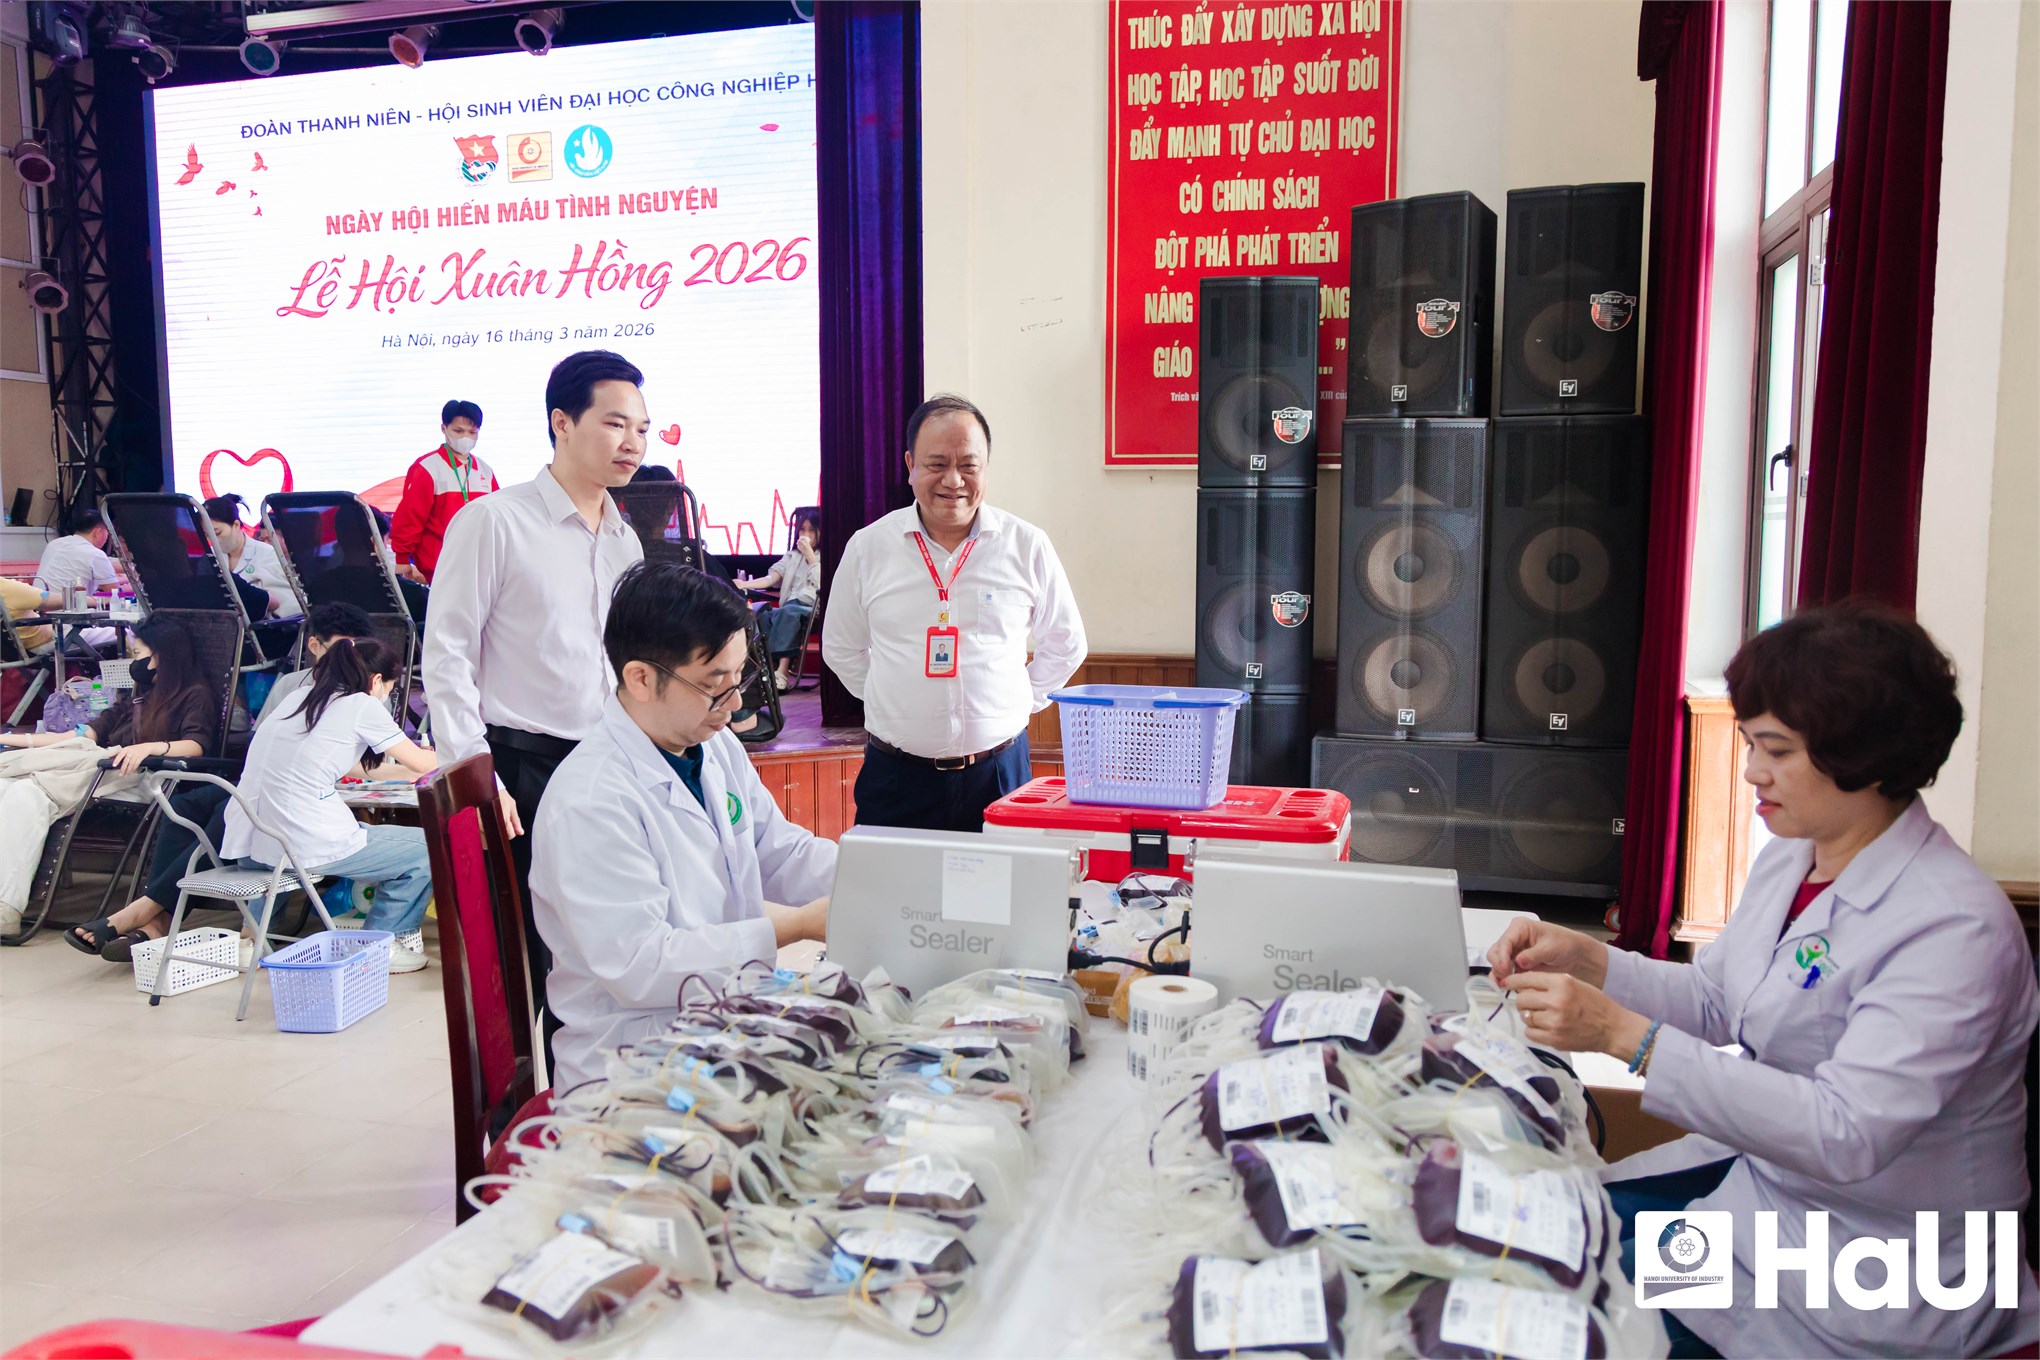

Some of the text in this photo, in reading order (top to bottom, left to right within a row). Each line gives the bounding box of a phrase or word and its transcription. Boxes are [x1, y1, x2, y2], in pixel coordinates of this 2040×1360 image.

[1128, 9, 1172, 49] THÚC
[1181, 0, 1214, 46] ĐẨY
[1221, 2, 1255, 43] XÂY
[1261, 3, 1313, 46] DỰNG
[1128, 48, 1379, 111] HỌC TẬP, HỌC TẬP SUỐT ĐỜI
[241, 119, 292, 138] ĐOÀN
[297, 115, 360, 133] THANH
[367, 108, 411, 127] NIÊN
[429, 103, 460, 124] HỘI
[467, 101, 511, 118] SINH
[518, 94, 563, 113] VIÊN
[569, 92, 601, 110] ĐẠI
[609, 88, 650, 107] HỌC
[657, 81, 715, 100] CÔNG
[722, 72, 800, 94] NGHIỆP
[1130, 109, 1376, 164] ĐẨY MẠNH TỰ CHỦ ĐẠI HỌC
[326, 186, 718, 235] NGÀY HỘI HIẾN MÁU TÌNH NGUYỆN
[1179, 169, 1320, 214] CÓ CHÍNH SÁCH
[1155, 216, 1339, 276] ĐỘT PHÁ PHÁT TRIỂN
[276, 237, 811, 318] Lễ Hội Xuân Hồng 2026
[1144, 285, 1193, 324] NÂNG
[381, 323, 655, 349] Hà Nội, ngày 16 tháng 3 năm 2026
[1153, 340, 1193, 378] GIÁO
[910, 924, 994, 954] Sealer
[1263, 944, 1314, 962] Smart
[1273, 964, 1362, 992] Seale
